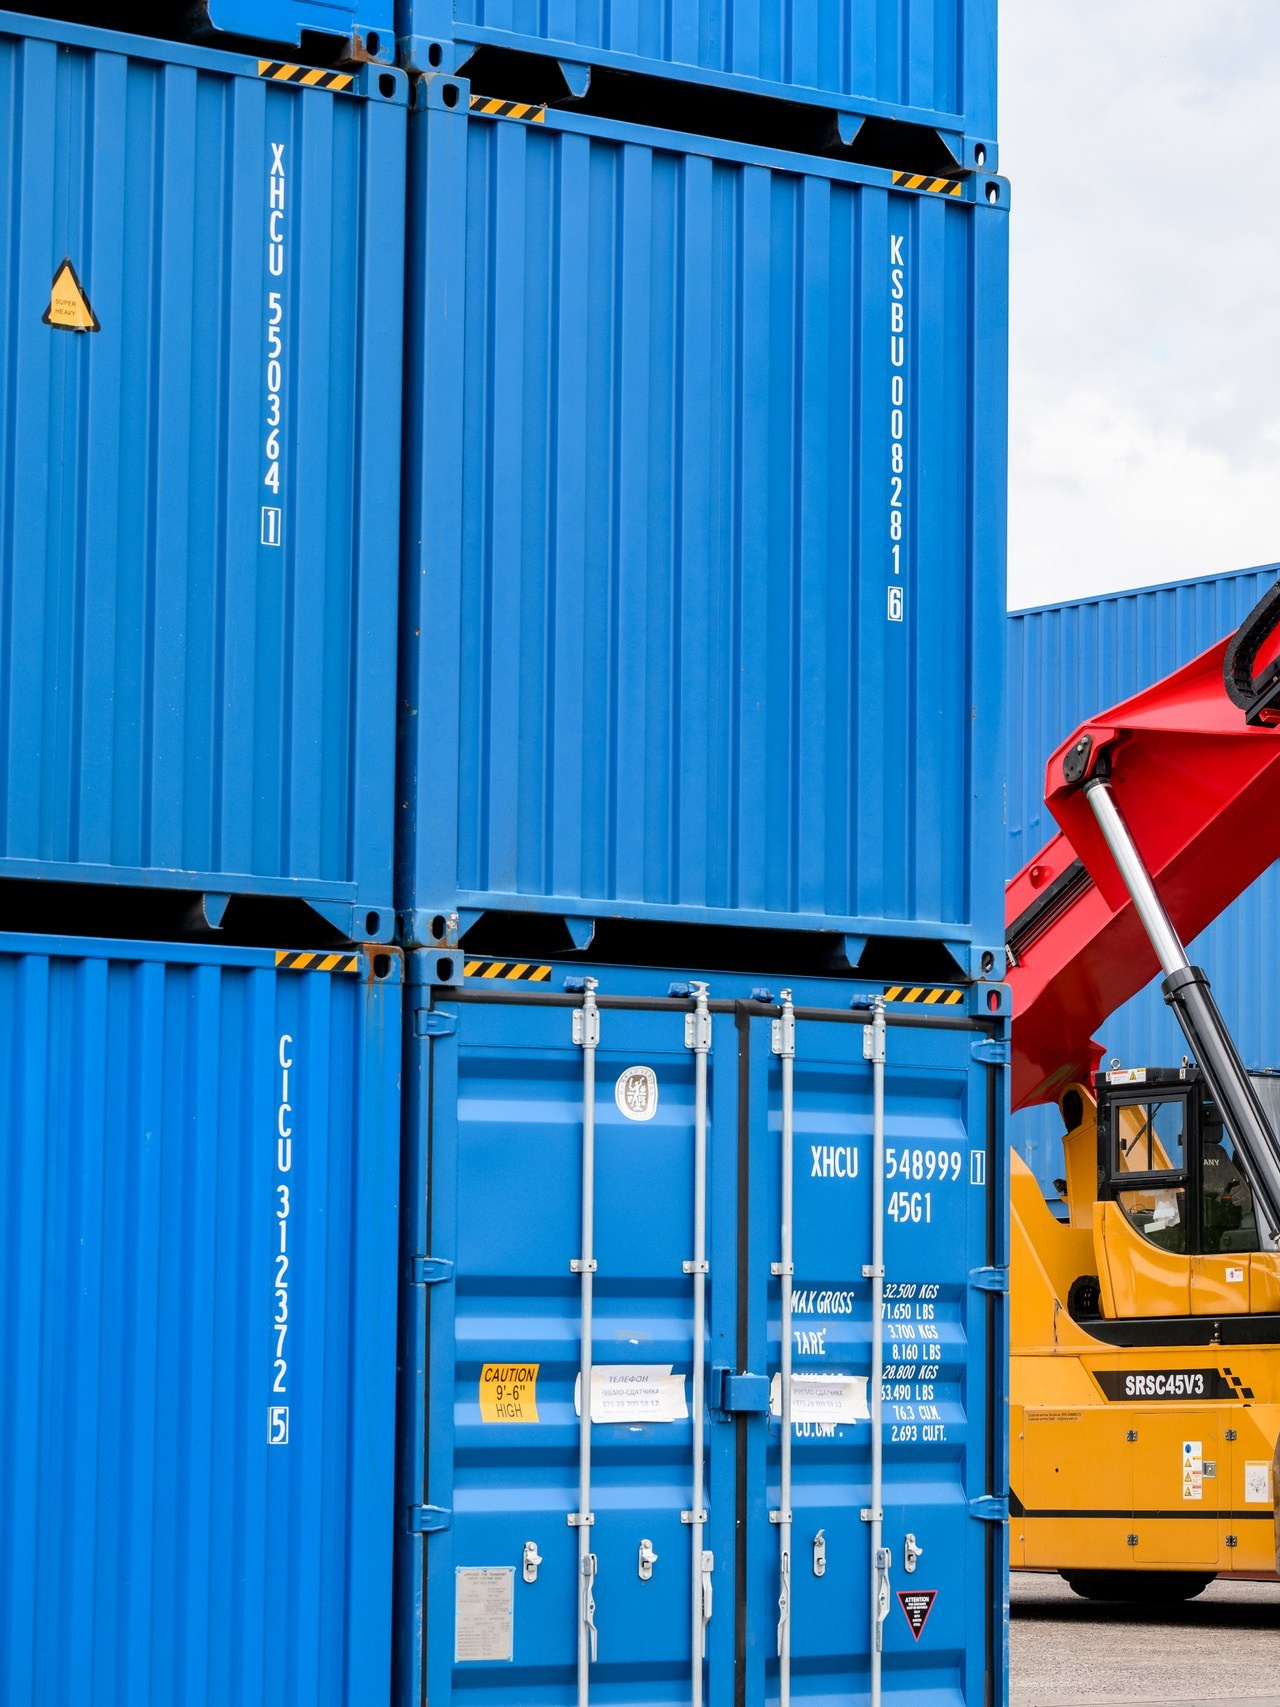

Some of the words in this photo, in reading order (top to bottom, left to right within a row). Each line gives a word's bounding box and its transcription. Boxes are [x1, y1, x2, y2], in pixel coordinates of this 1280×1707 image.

[268, 143, 286, 276] XHCU
[55, 298, 77, 307] SUPER
[890, 234, 904, 367] KSBU
[55, 308, 76, 316] HEAVY
[264, 293, 283, 495] 550364
[890, 375, 904, 575] 008281
[277, 1034, 293, 1172] CICU
[811, 1145, 859, 1178] XHCU
[884, 1148, 962, 1181] 548999
[887, 1191, 931, 1223] 45G1
[272, 1184, 290, 1393] 312372
[918, 1284, 940, 1299] KGS
[791, 1290, 817, 1313] MAX
[817, 1291, 855, 1314] GROSS
[916, 1303, 935, 1320] LBS
[917, 1324, 939, 1339] KGS
[923, 1344, 941, 1360] LBS
[484, 1368, 536, 1382] CAUTION
[608, 1375, 649, 1383] ТЕЛЕФОН
[918, 1365, 939, 1380] KGS
[916, 1384, 934, 1400] LBS
[1125, 1374, 1204, 1396] SRSC45V3
[495, 1403, 523, 1418] HIGH
[892, 1405, 915, 1420] 76.3
